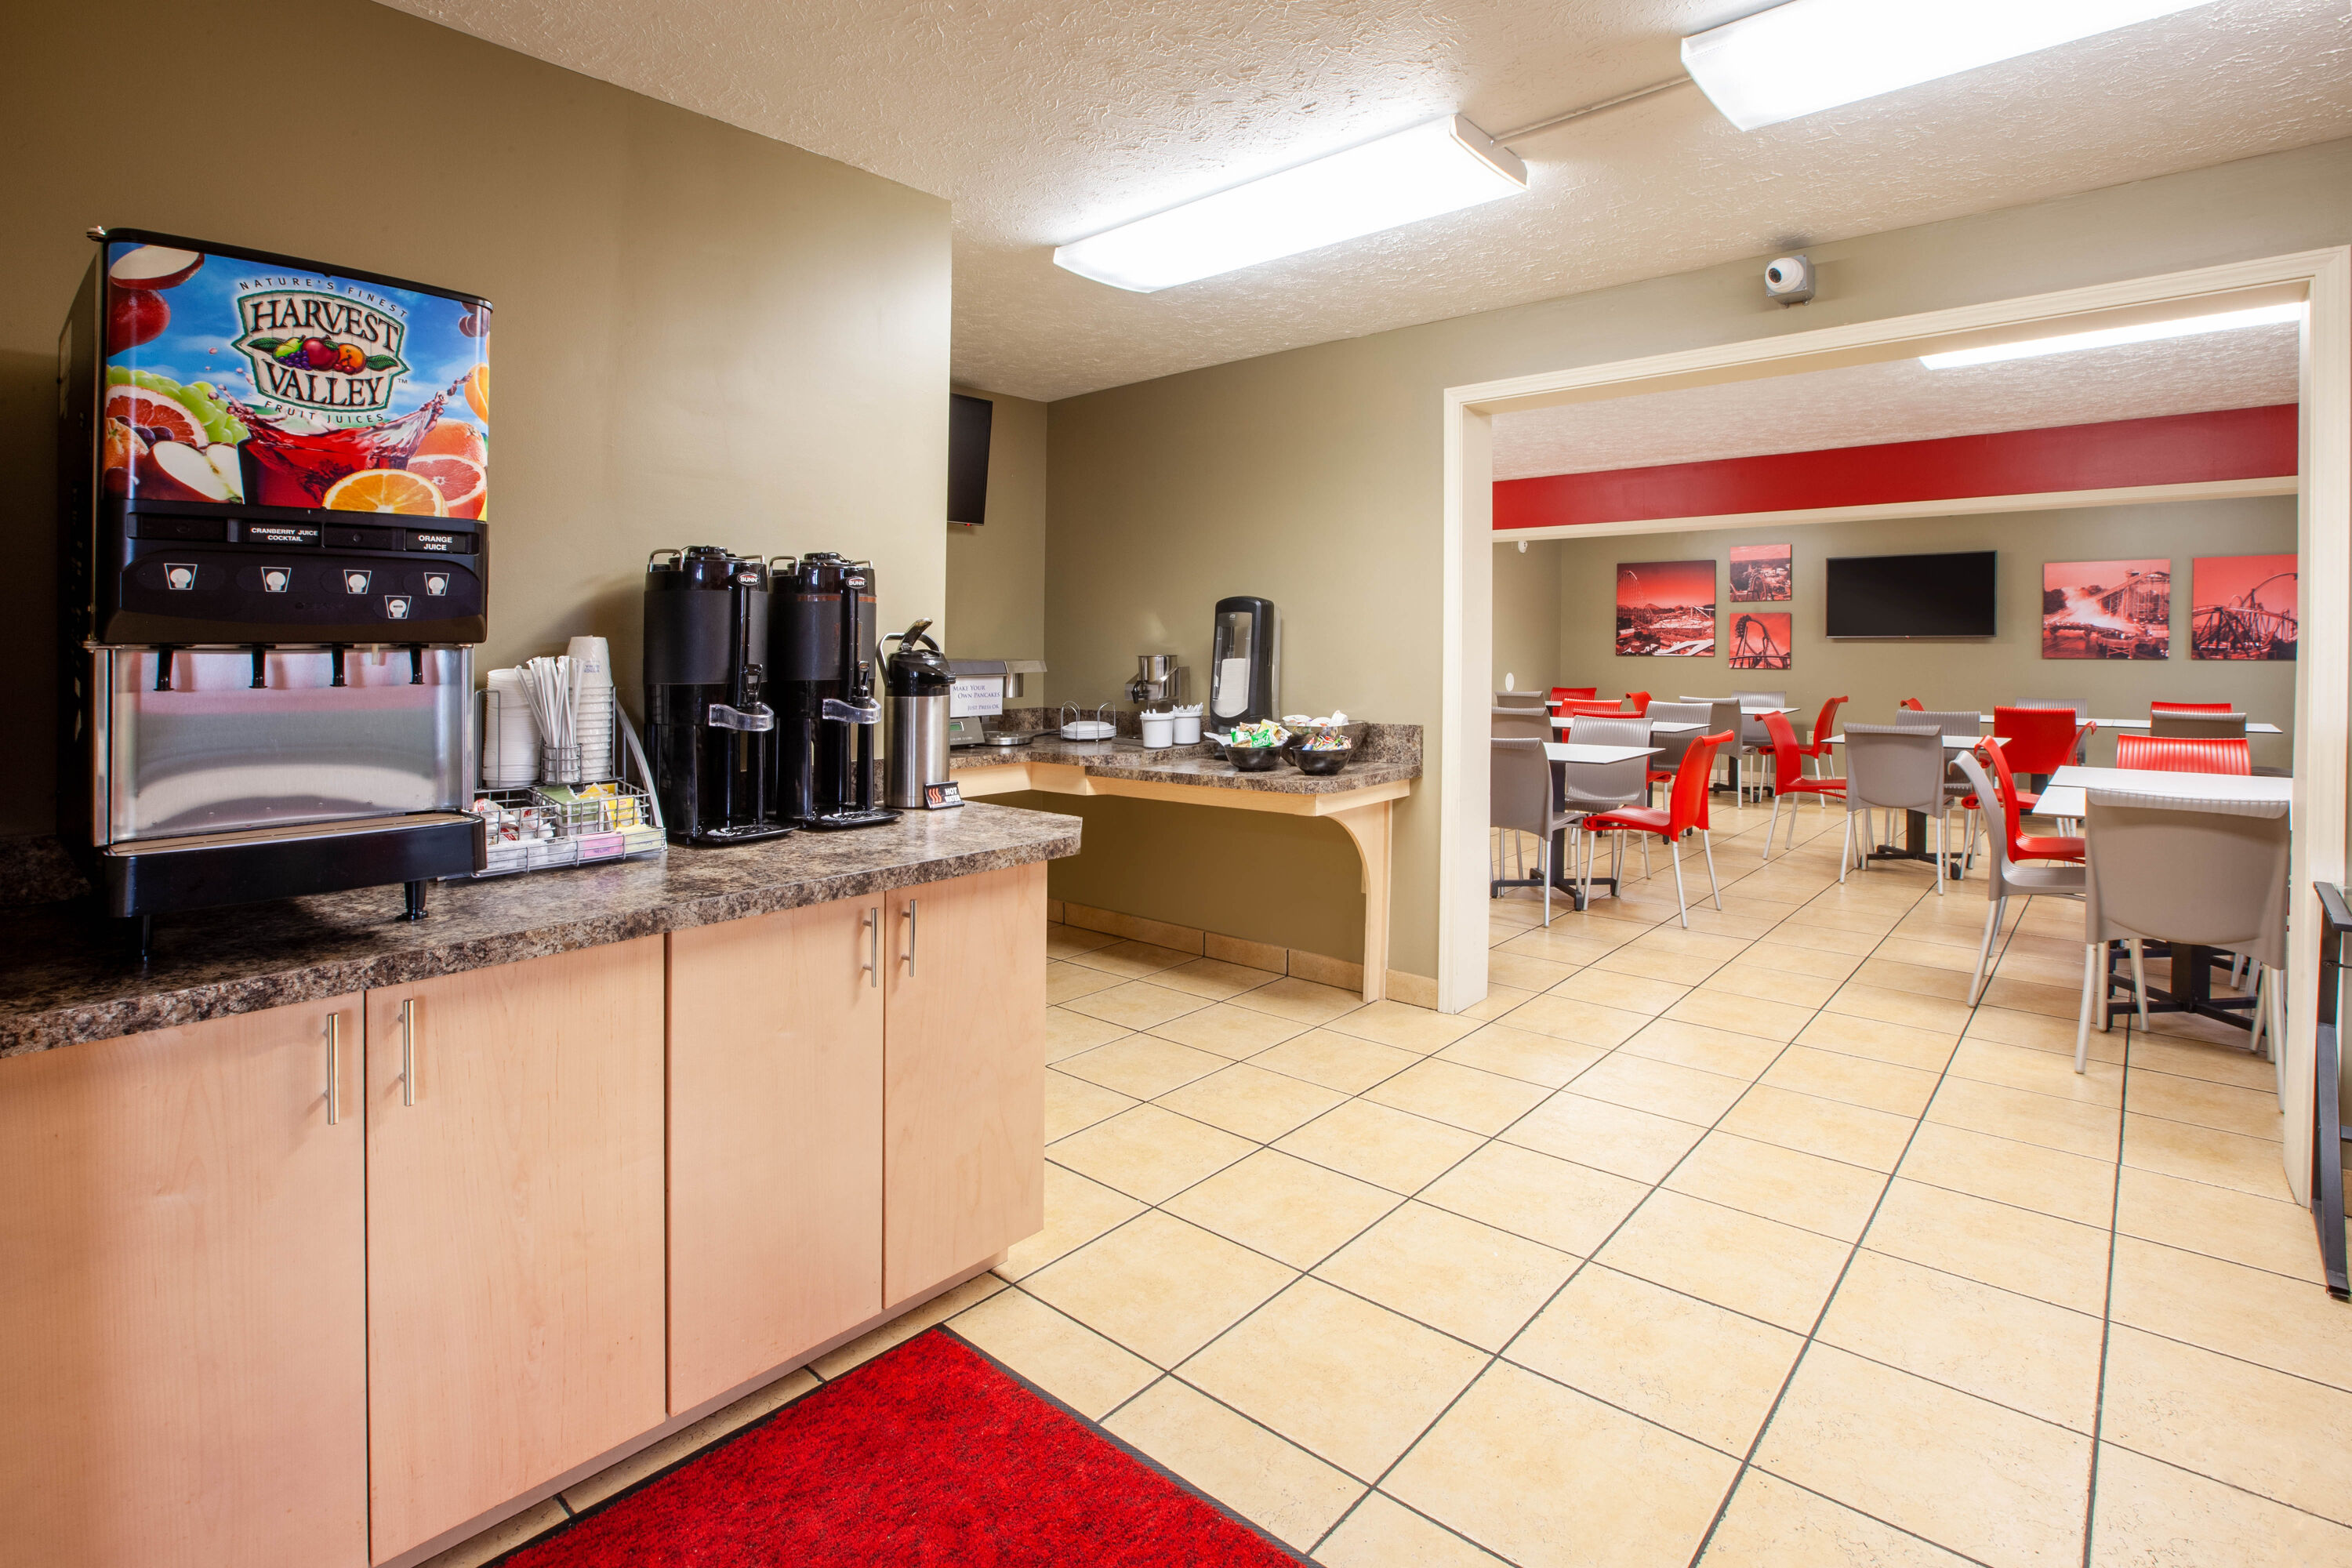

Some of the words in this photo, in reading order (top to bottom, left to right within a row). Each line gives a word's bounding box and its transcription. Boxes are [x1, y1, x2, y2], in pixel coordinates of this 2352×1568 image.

[239, 278, 334, 290] NATURE'S
[348, 287, 408, 318] FINEST
[249, 297, 399, 352] HARVEST
[261, 358, 385, 407] VALLEY
[264, 401, 315, 420] FRUIT
[327, 413, 383, 423] JUICES
[251, 527, 296, 535] CRANBERRY
[418, 535, 453, 543] ORANGE
[944, 786, 957, 796] HOT
[944, 794, 961, 803] WATER
